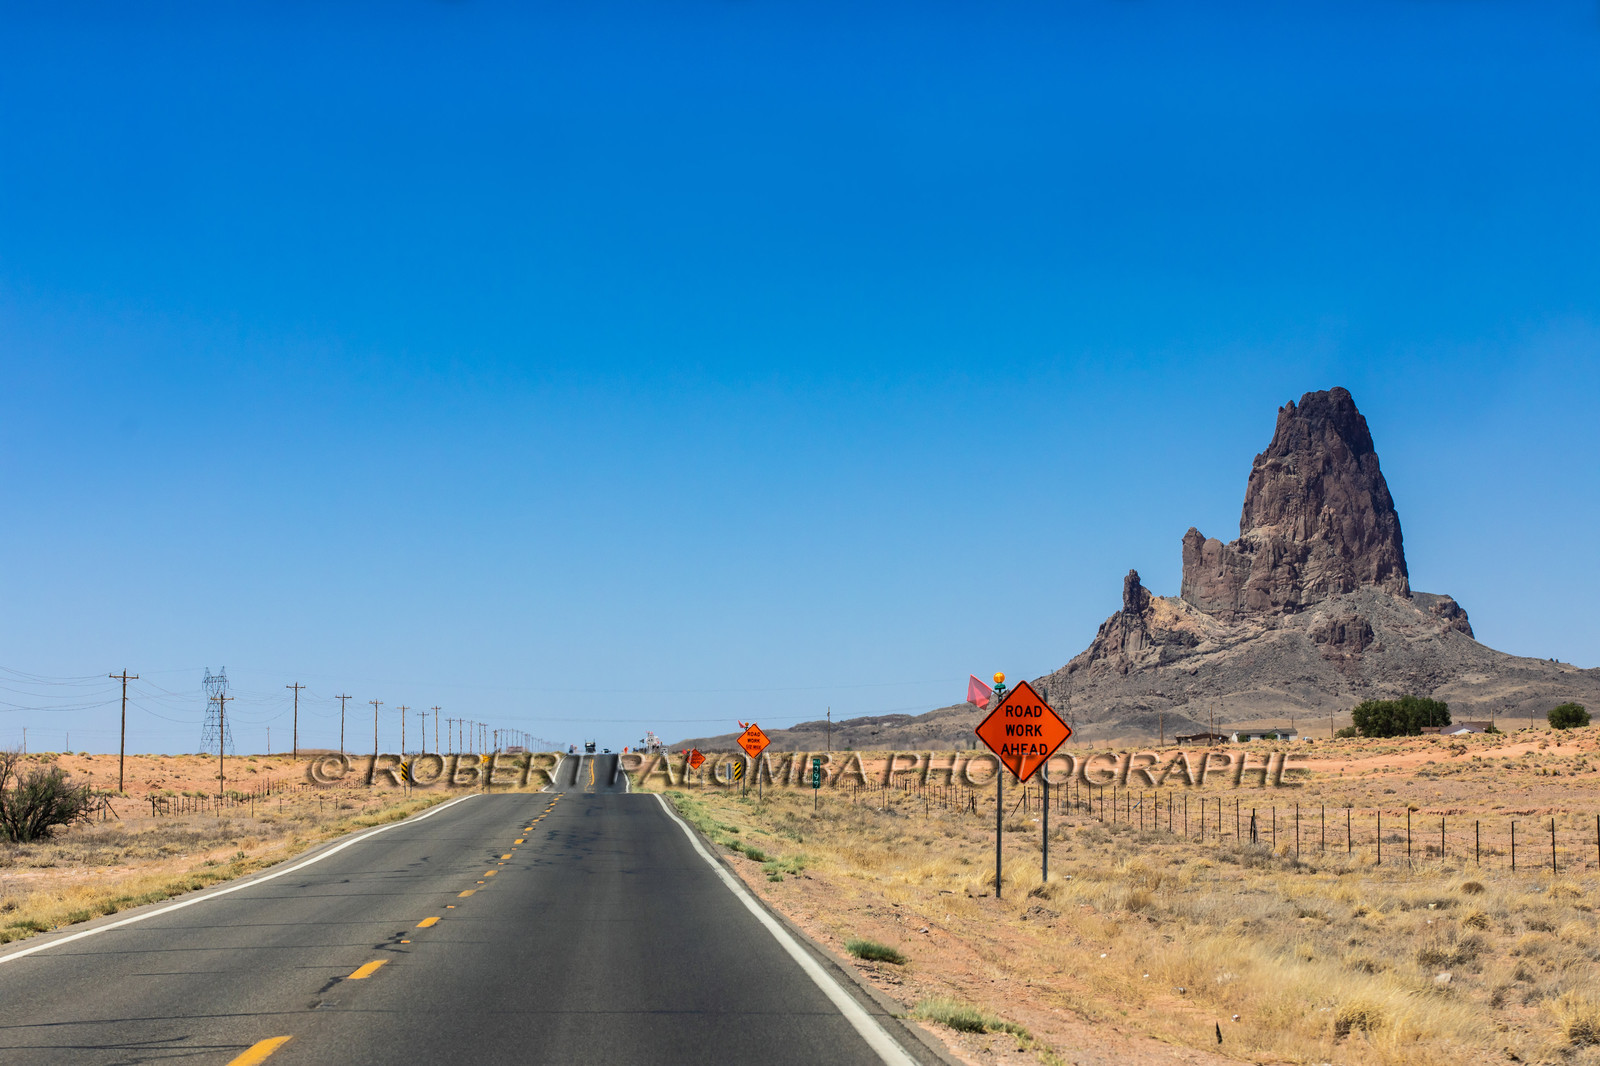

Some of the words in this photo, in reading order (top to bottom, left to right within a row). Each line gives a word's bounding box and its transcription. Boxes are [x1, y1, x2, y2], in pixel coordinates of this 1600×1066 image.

[1005, 705, 1042, 718] ROAD
[1005, 724, 1042, 737] WORK
[1000, 743, 1048, 756] AHEAD
